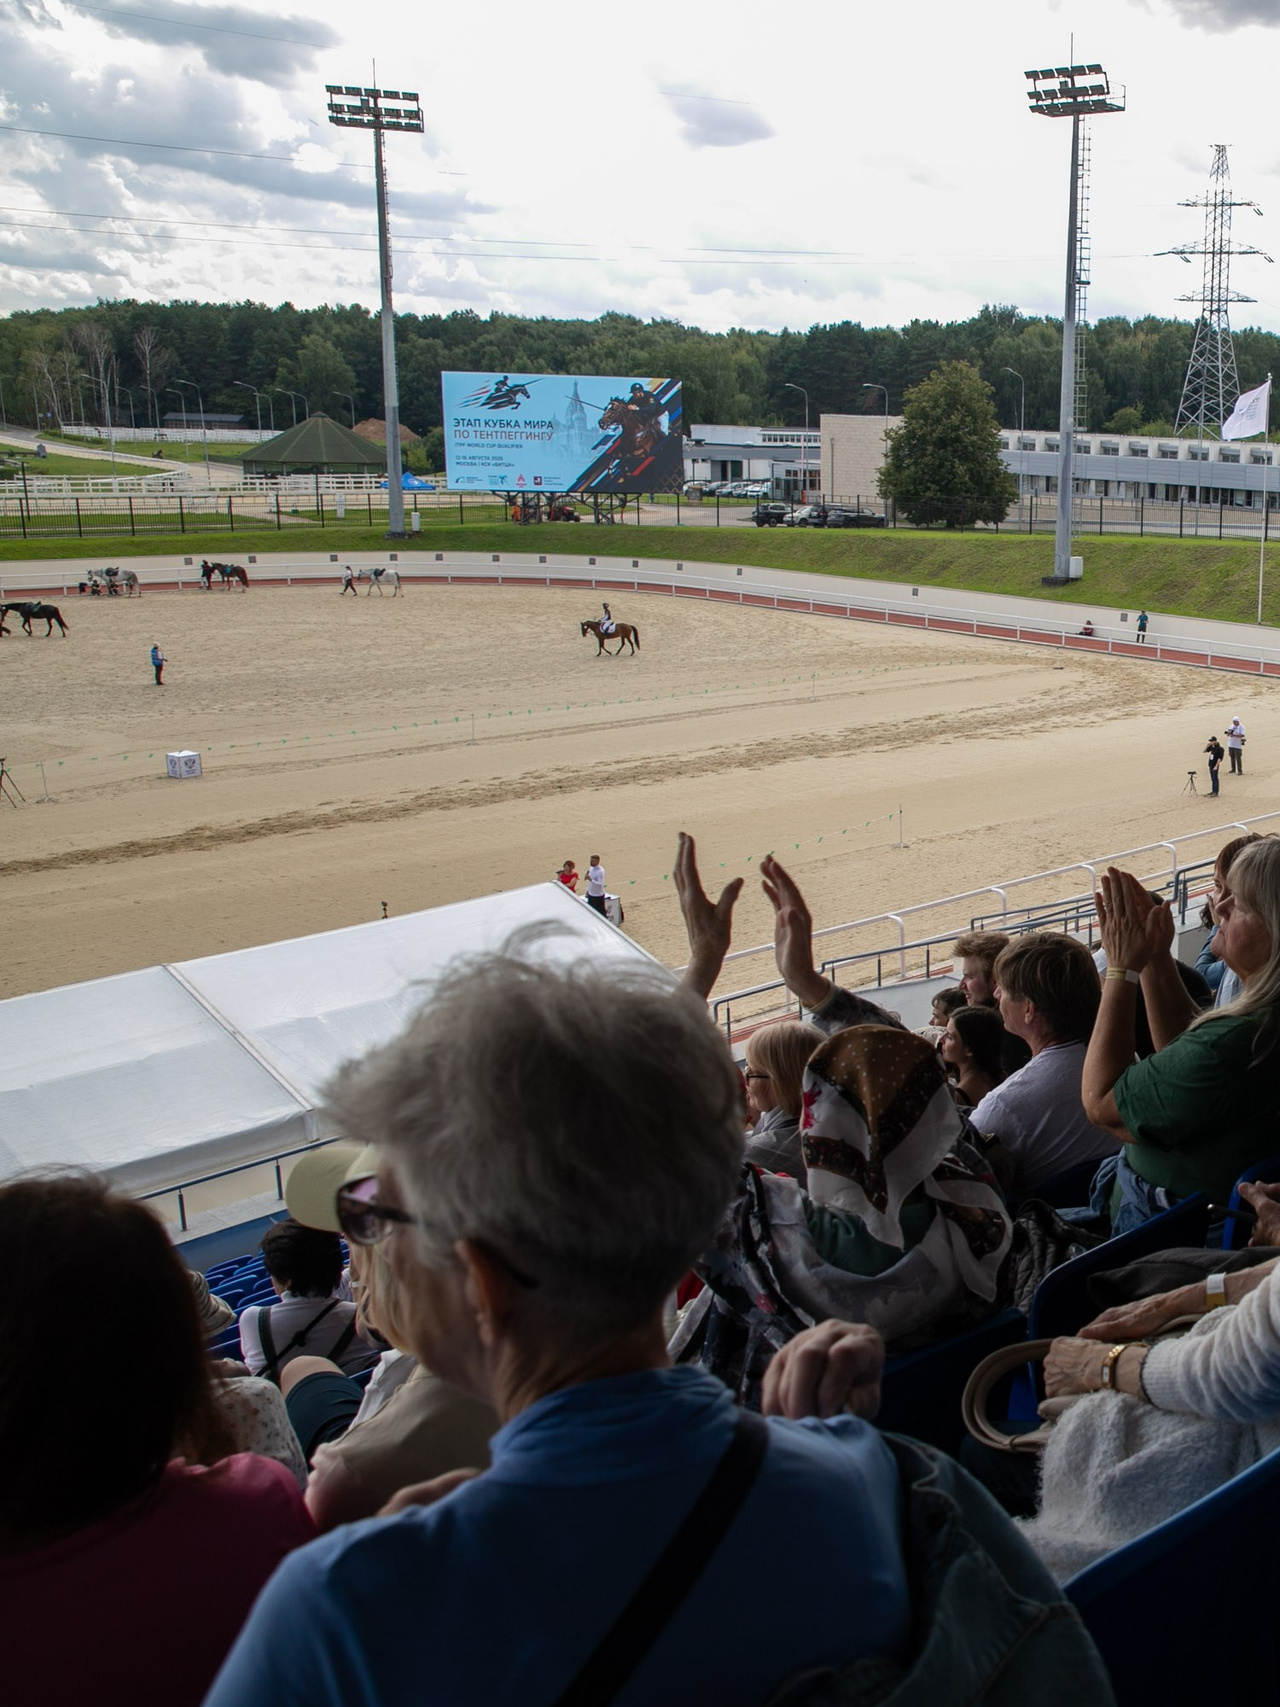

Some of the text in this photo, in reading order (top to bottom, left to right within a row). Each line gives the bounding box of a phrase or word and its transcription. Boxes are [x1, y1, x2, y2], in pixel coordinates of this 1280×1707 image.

[453, 418, 554, 430] ЭТАП КУБКА МИРА
[454, 430, 553, 441] ПО ТЕНТПЕГГИНГУ
